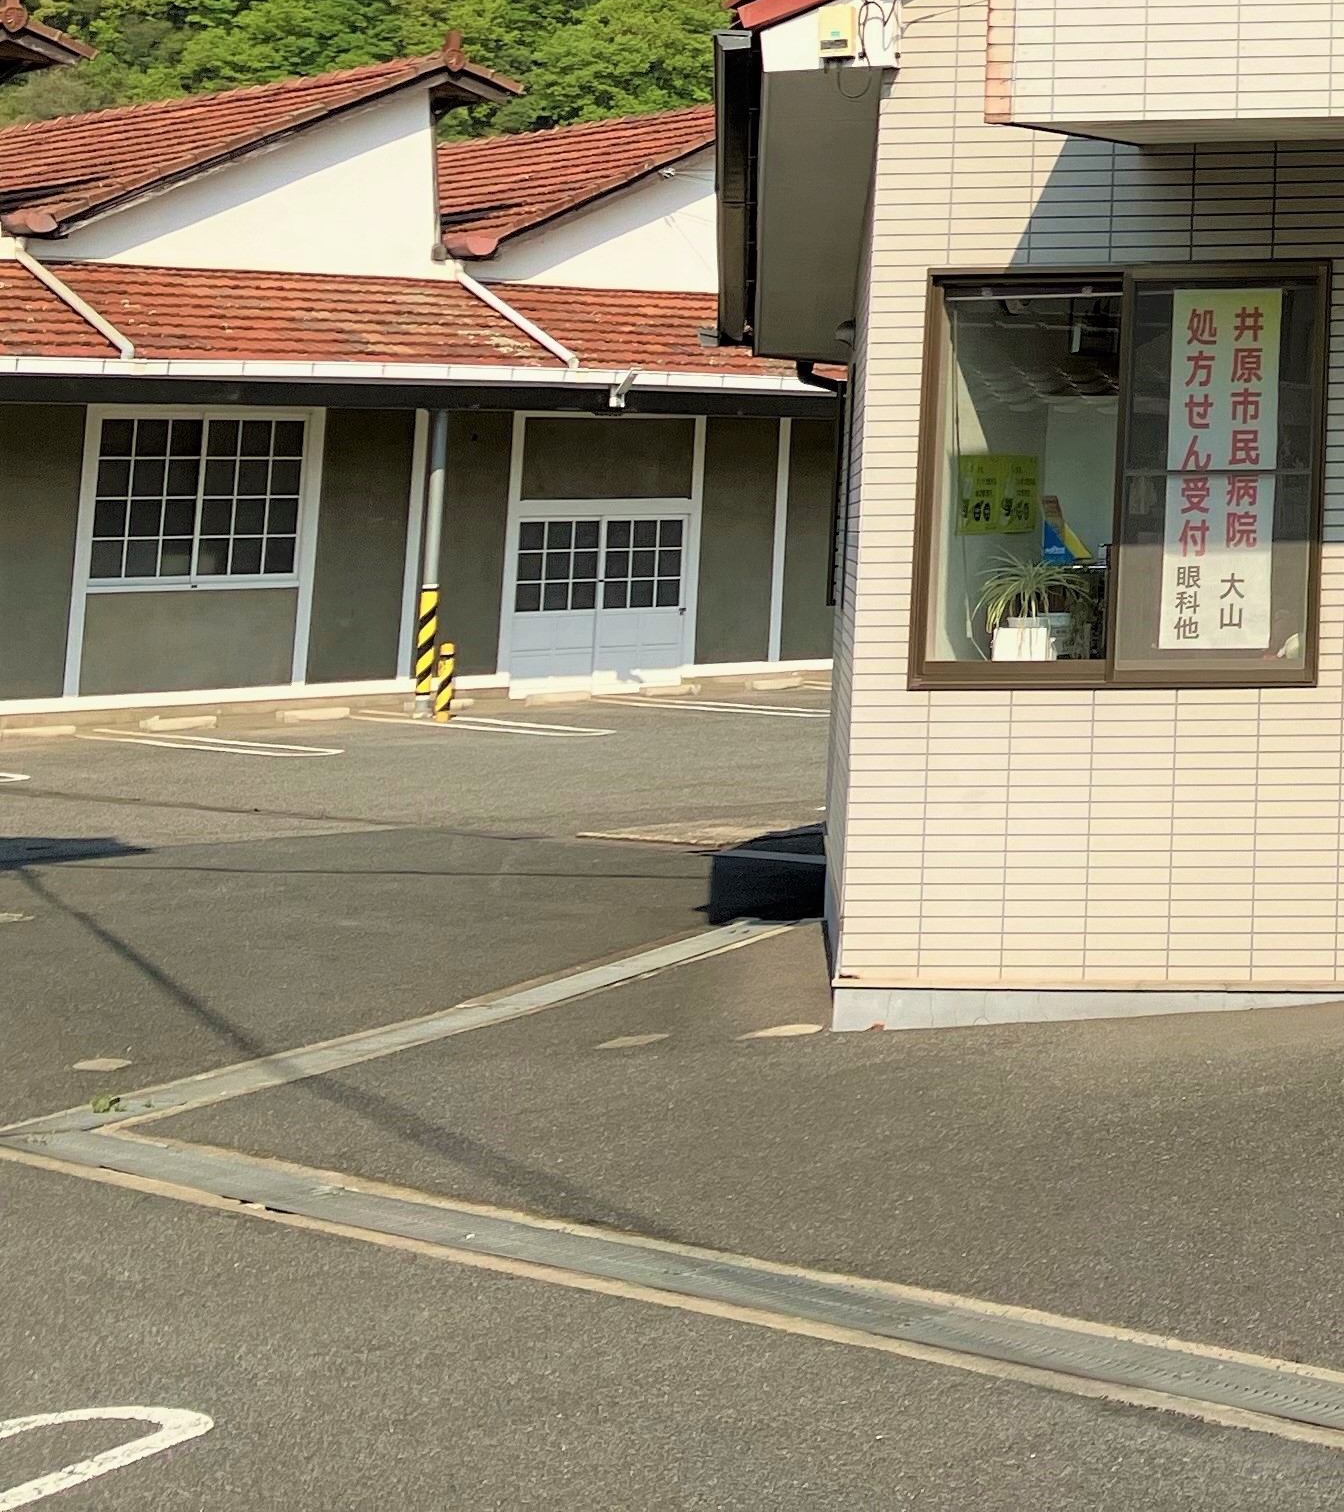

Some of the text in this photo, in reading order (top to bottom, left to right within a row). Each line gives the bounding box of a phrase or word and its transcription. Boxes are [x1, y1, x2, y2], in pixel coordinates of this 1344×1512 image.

[1178, 307, 1218, 558] 処方せん受付
[1225, 306, 1264, 549] 井原市民病院
[1173, 565, 1201, 640] 眼科他
[1219, 573, 1245, 630] 大山
